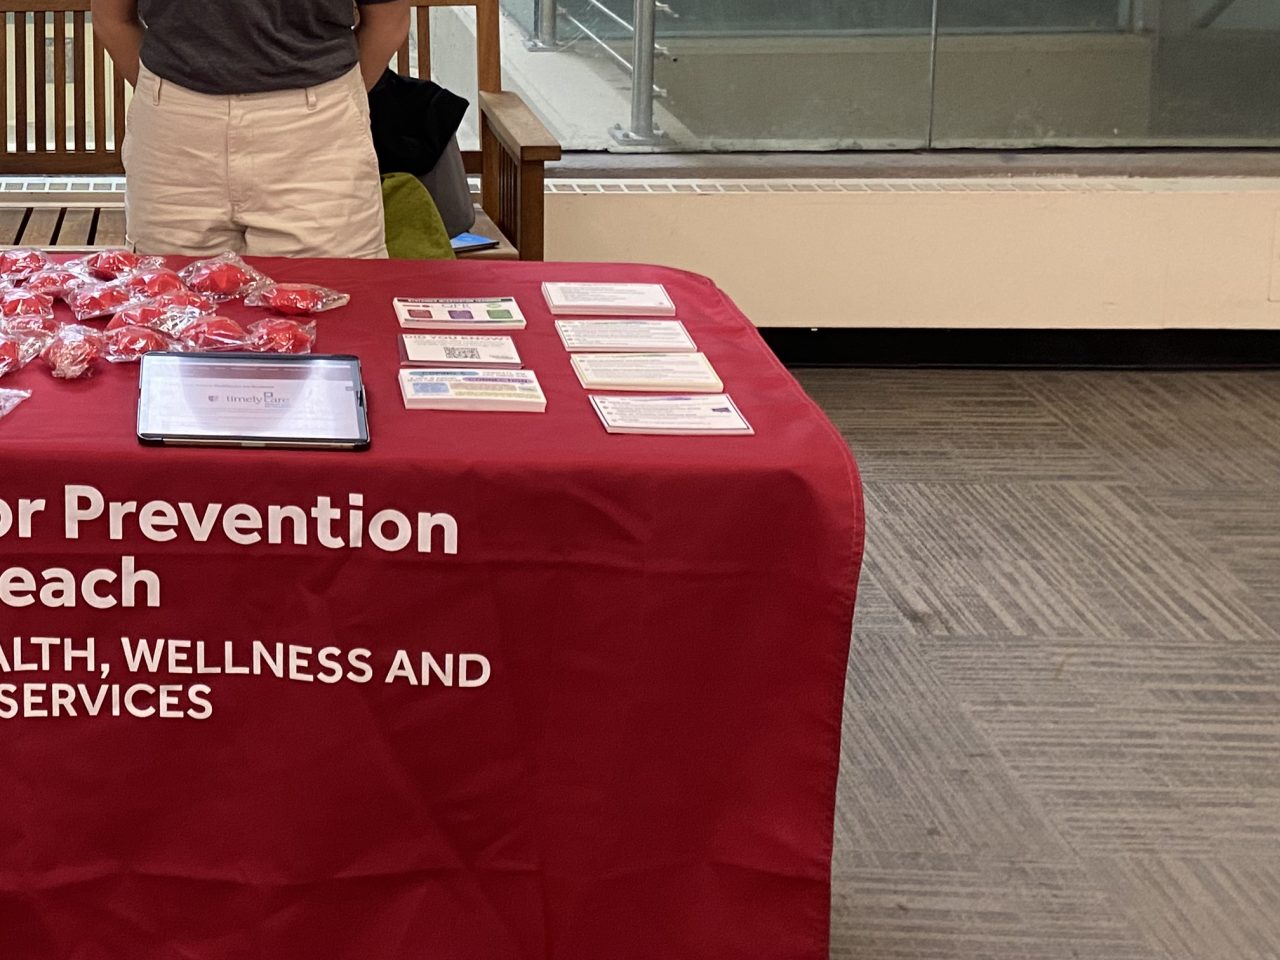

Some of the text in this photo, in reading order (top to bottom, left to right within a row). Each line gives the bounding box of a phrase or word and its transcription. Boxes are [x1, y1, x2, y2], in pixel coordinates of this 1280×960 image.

[64, 483, 459, 555] Prevention
[120, 636, 373, 684] WELLNESS
[384, 649, 492, 688] AND
